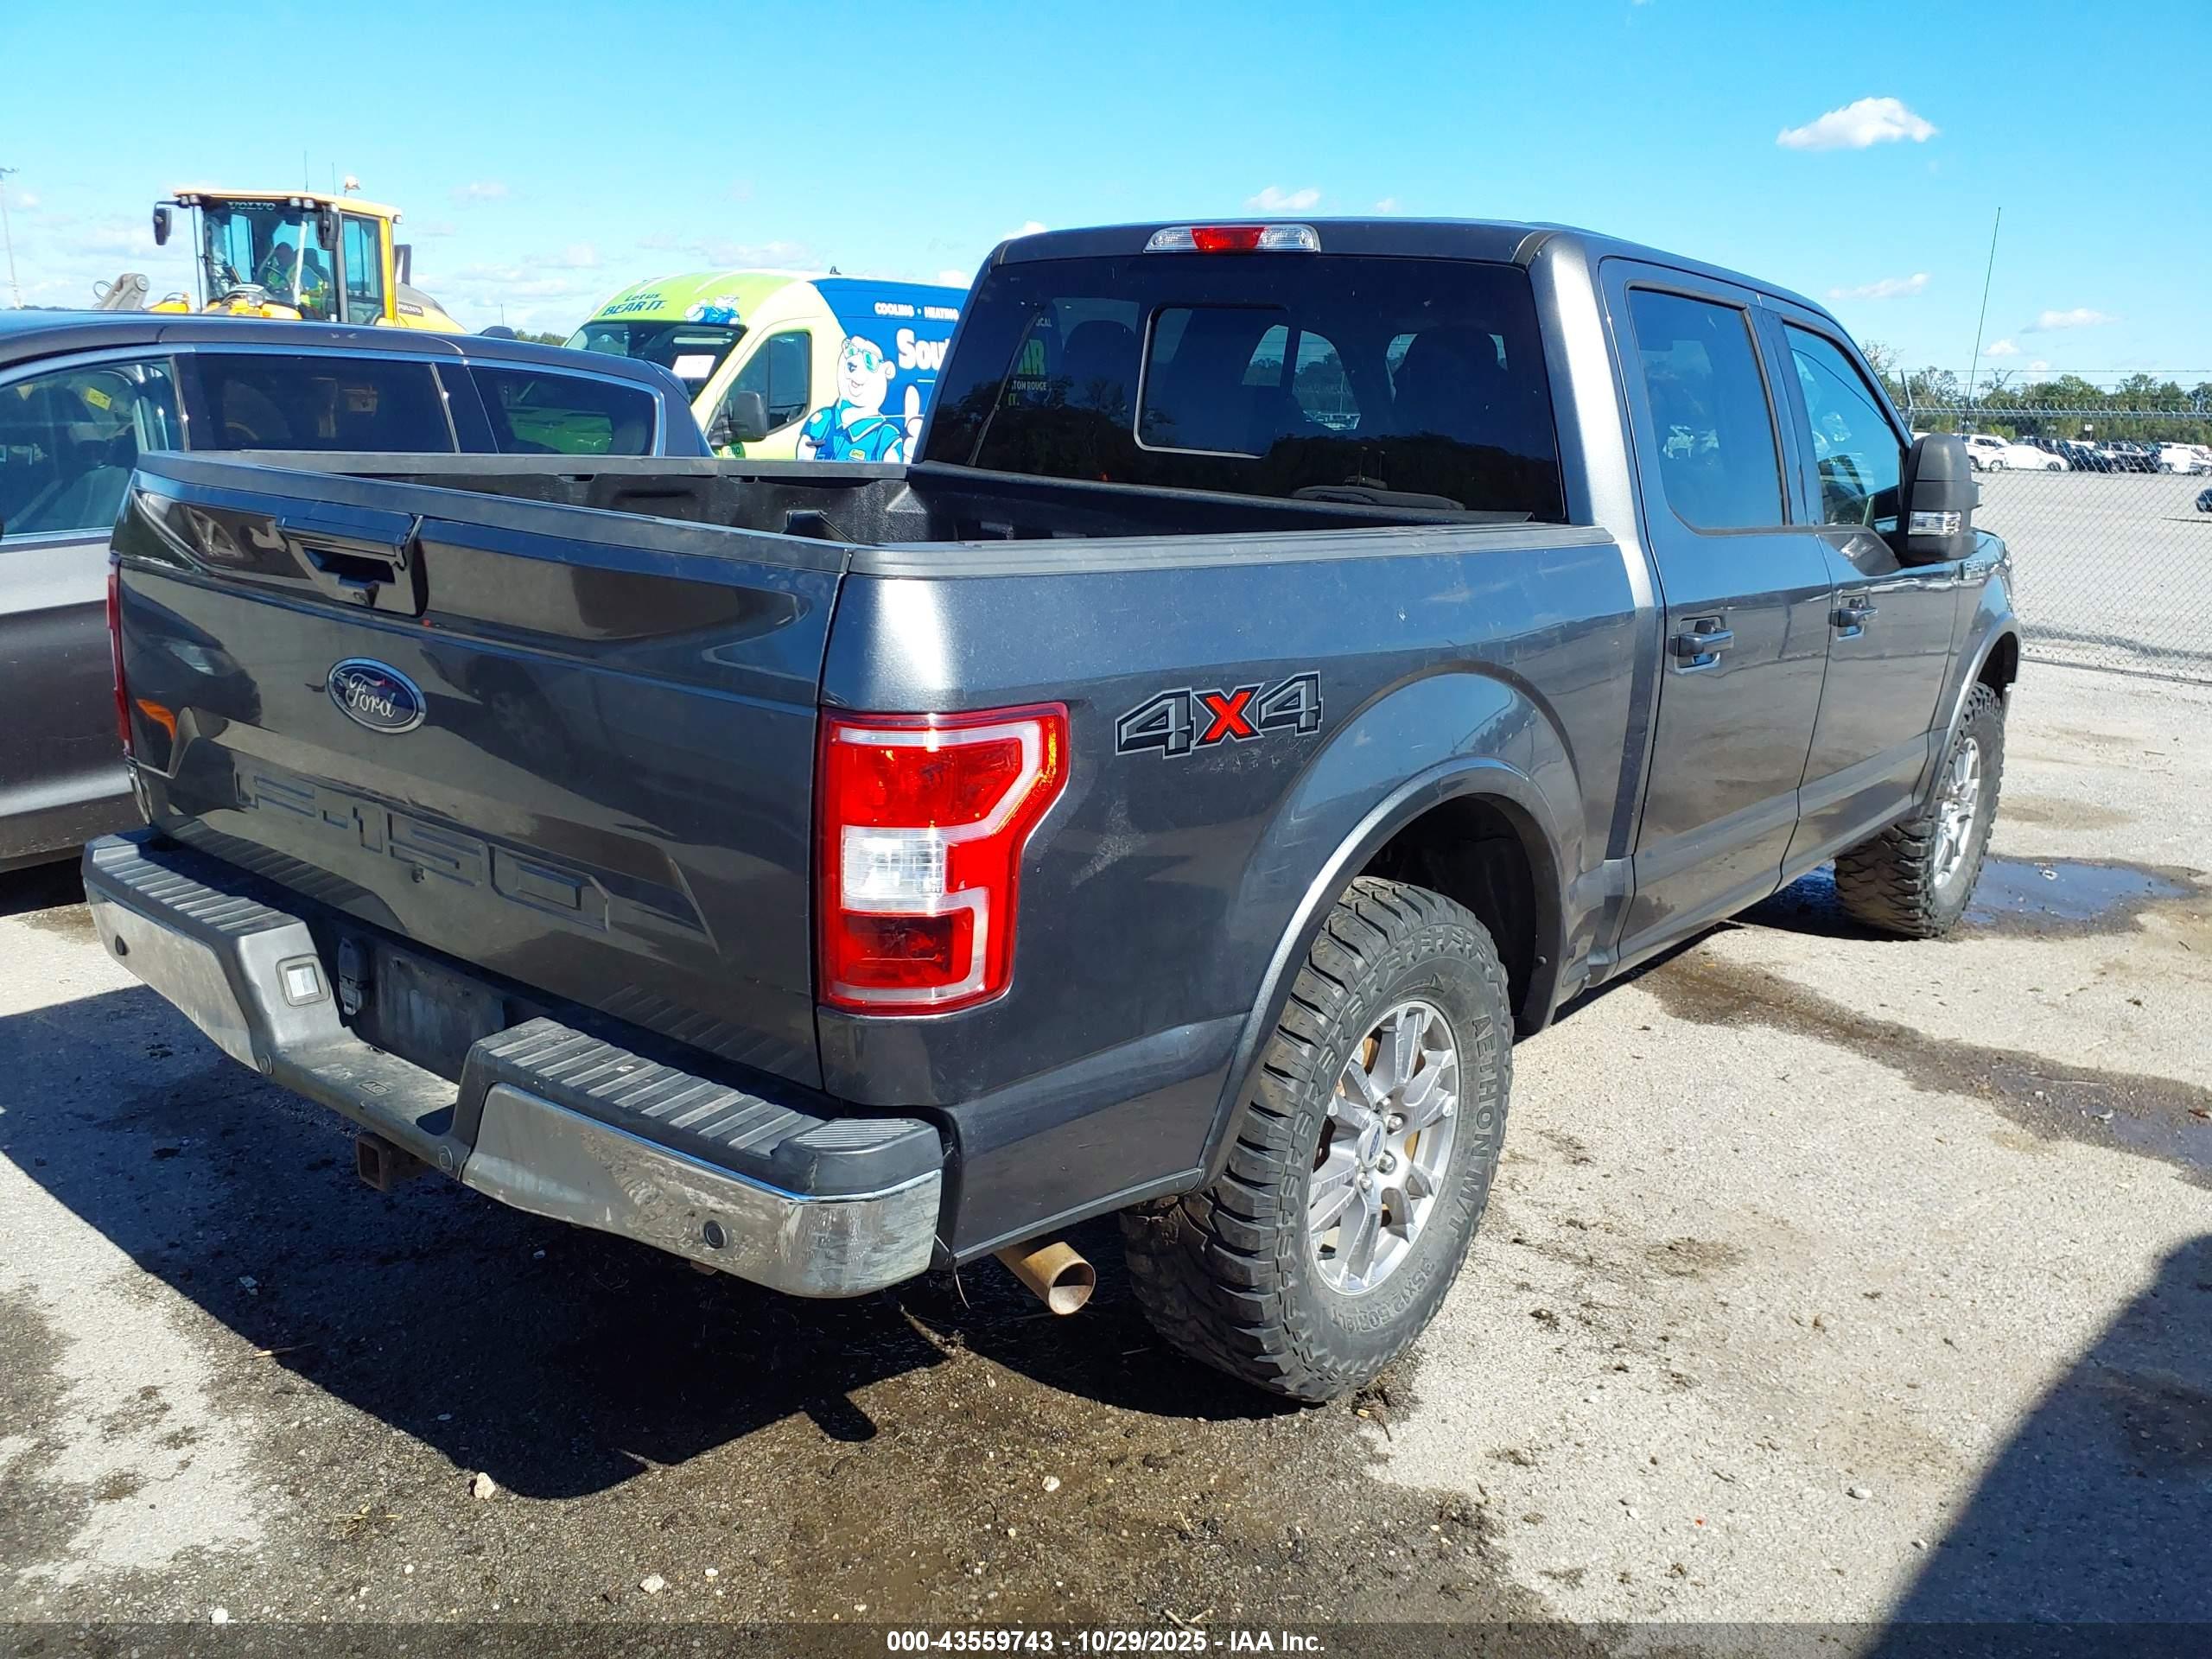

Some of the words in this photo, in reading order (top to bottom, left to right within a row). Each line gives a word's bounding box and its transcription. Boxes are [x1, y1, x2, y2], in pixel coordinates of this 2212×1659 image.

[227, 201, 276, 211] VOLVO
[601, 301, 646, 316] BEAR
[874, 302, 915, 317] COOLING
[924, 306, 959, 321] HEATING
[346, 672, 396, 718] Ford
[235, 772, 610, 932] F-150
[1471, 1015, 1498, 1159] AETHON
[1448, 1169, 1483, 1241] M/T
